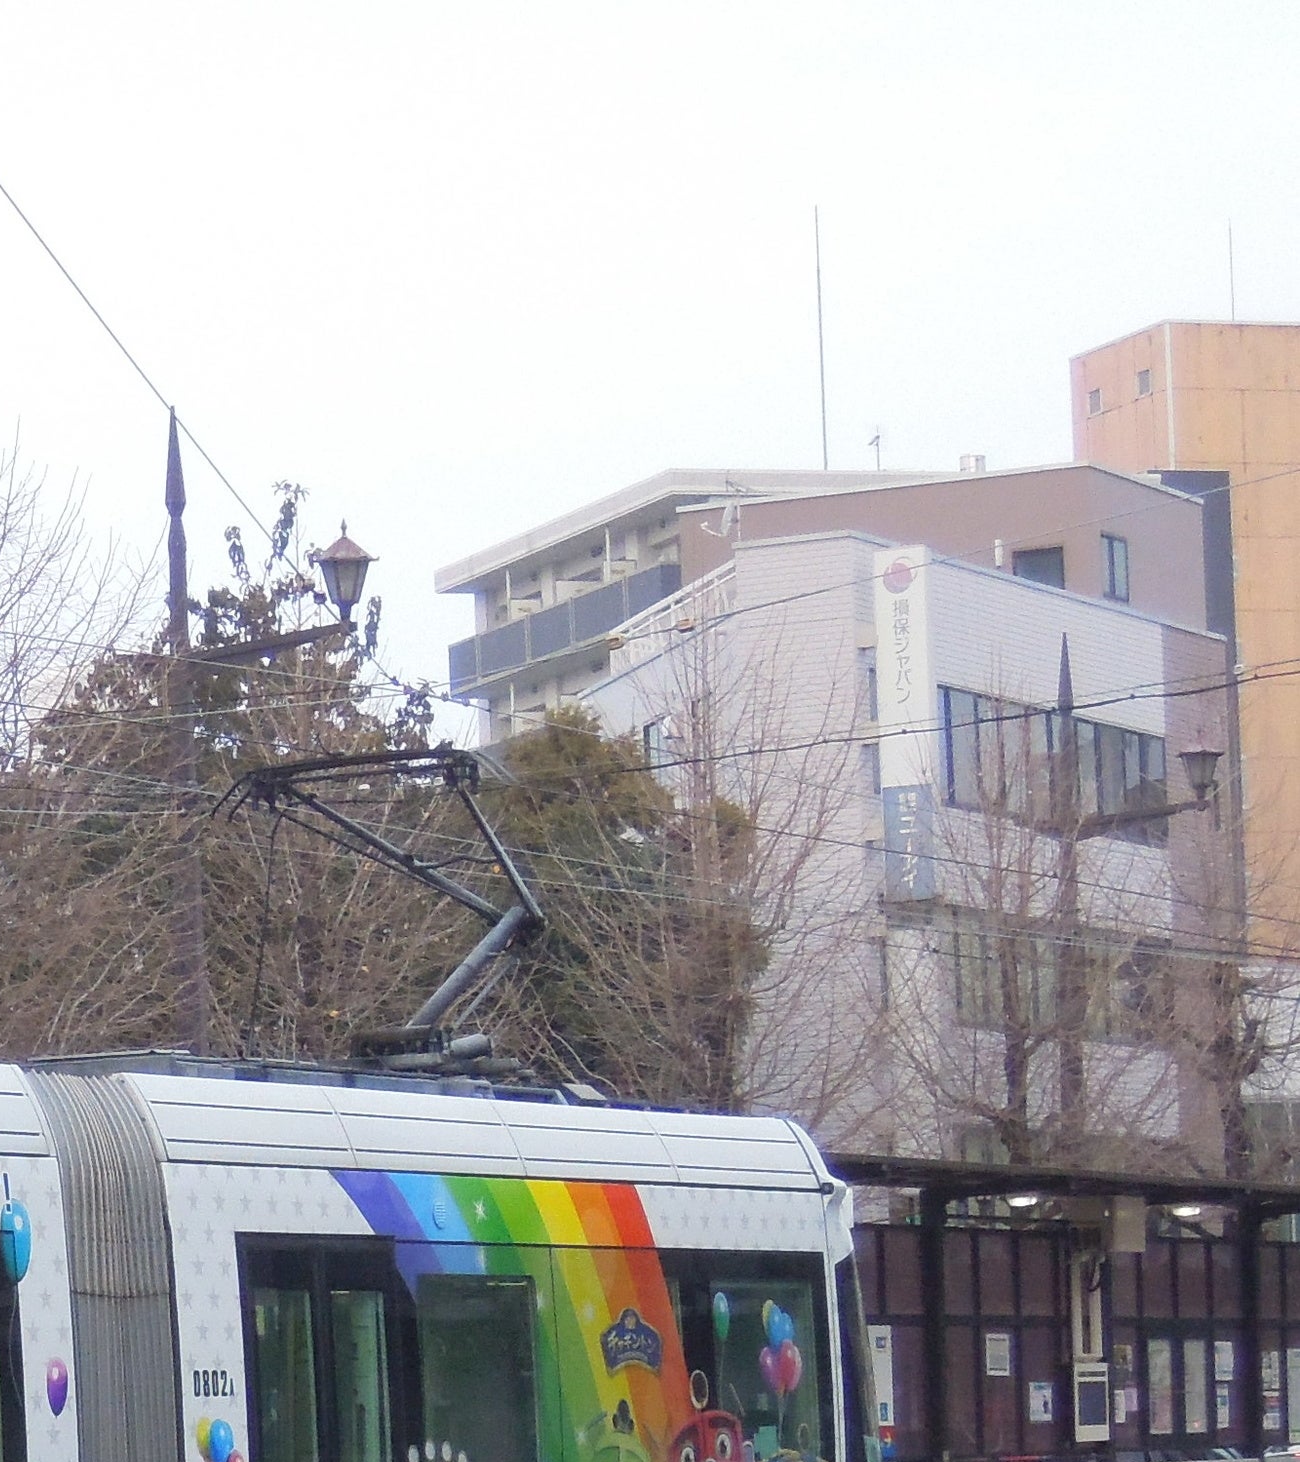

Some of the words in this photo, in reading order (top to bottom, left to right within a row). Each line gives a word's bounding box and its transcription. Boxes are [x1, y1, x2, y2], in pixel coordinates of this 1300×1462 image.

[890, 598, 913, 705] 損保ジャパン
